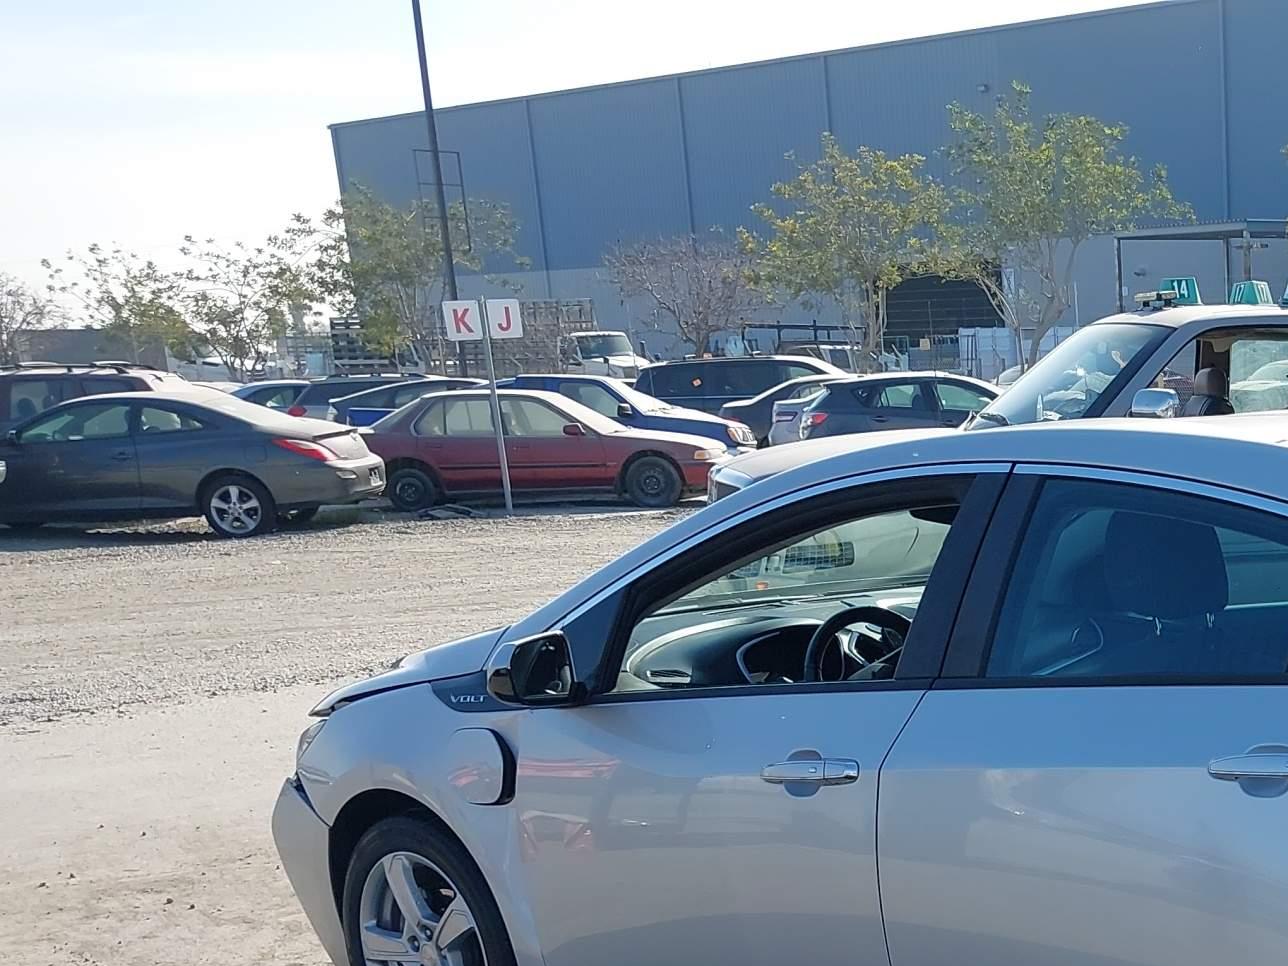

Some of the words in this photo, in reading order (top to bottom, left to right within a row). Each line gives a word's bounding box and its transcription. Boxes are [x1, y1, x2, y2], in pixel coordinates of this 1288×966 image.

[1173, 280, 1188, 299] 14
[452, 308, 474, 334] K
[497, 306, 512, 332] J
[450, 695, 488, 703] VOLT
